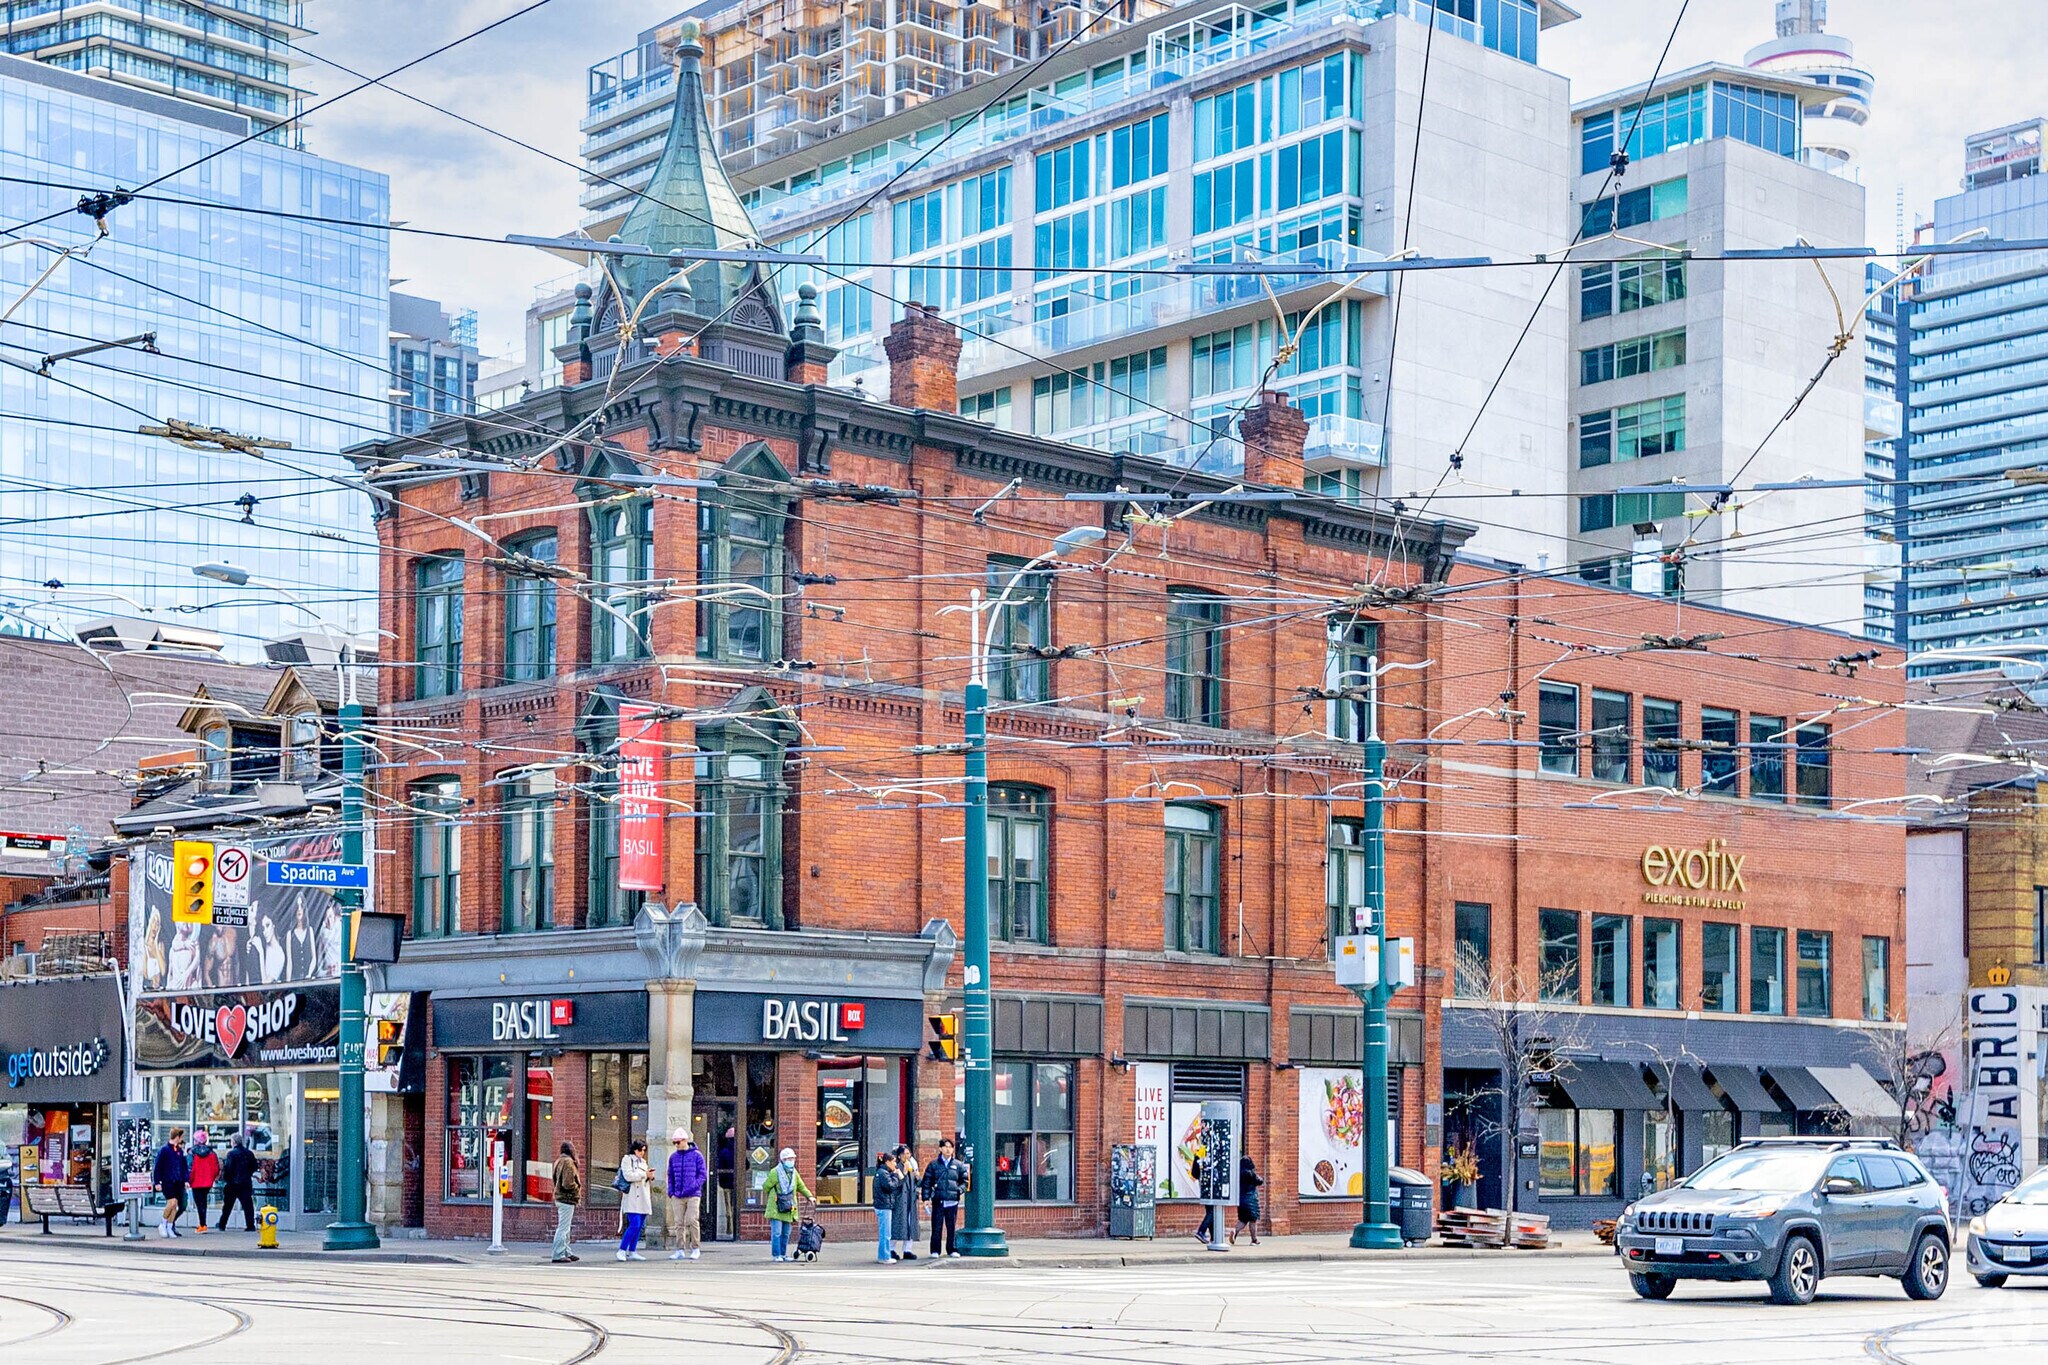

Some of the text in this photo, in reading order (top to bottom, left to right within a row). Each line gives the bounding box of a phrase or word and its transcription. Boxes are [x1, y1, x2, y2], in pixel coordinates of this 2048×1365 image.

[623, 755, 654, 776] LIVE
[624, 779, 658, 799] LOVE
[624, 803, 649, 823] EAT
[269, 845, 286, 858] YOUR
[624, 838, 658, 857] BASIL
[147, 850, 174, 894] LOV
[280, 863, 355, 883] Spadina Ave
[1641, 838, 1747, 892] exotix
[1645, 892, 1747, 910] PIERCING & FINE JEWELRY
[216, 916, 244, 925] EXCEPTED
[171, 1002, 216, 1044] LOVE
[246, 992, 297, 1042] SHOP
[492, 1000, 566, 1041] BASIL BOX
[763, 999, 861, 1042] BASIL BOX
[260, 1044, 337, 1062] www.loveshop.ca
[8, 1042, 92, 1088] getoutside
[1137, 1087, 1163, 1102] LIVE
[1137, 1106, 1165, 1121] LOVE
[1137, 1125, 1157, 1140] EAT
